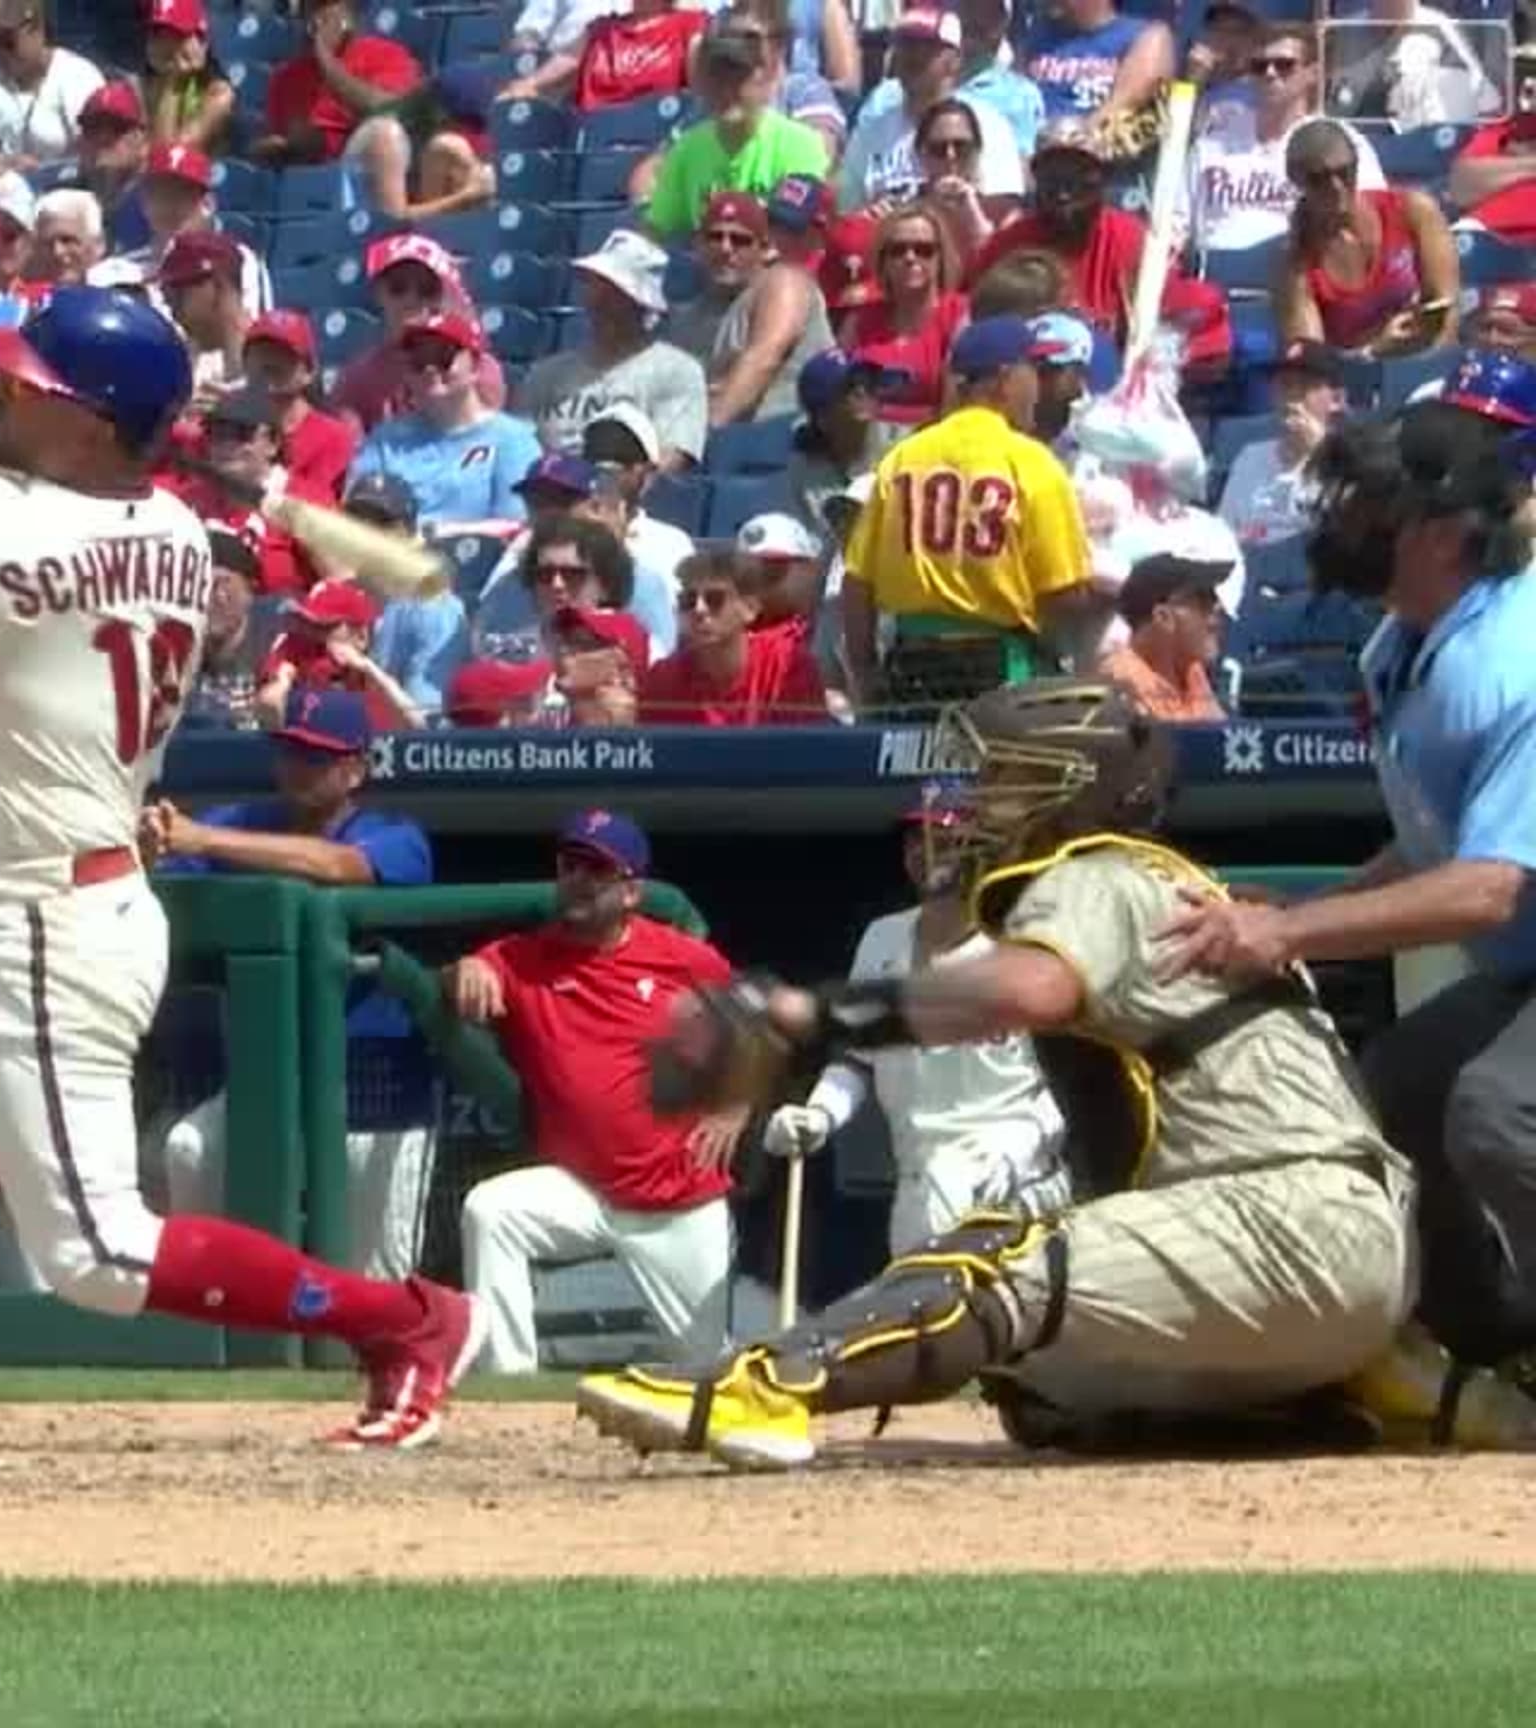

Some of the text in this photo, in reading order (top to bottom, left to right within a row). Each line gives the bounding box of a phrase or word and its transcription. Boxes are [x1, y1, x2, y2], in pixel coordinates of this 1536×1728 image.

[891, 471, 1014, 559] 103
[404, 737, 655, 772] Citizens Bank Park
